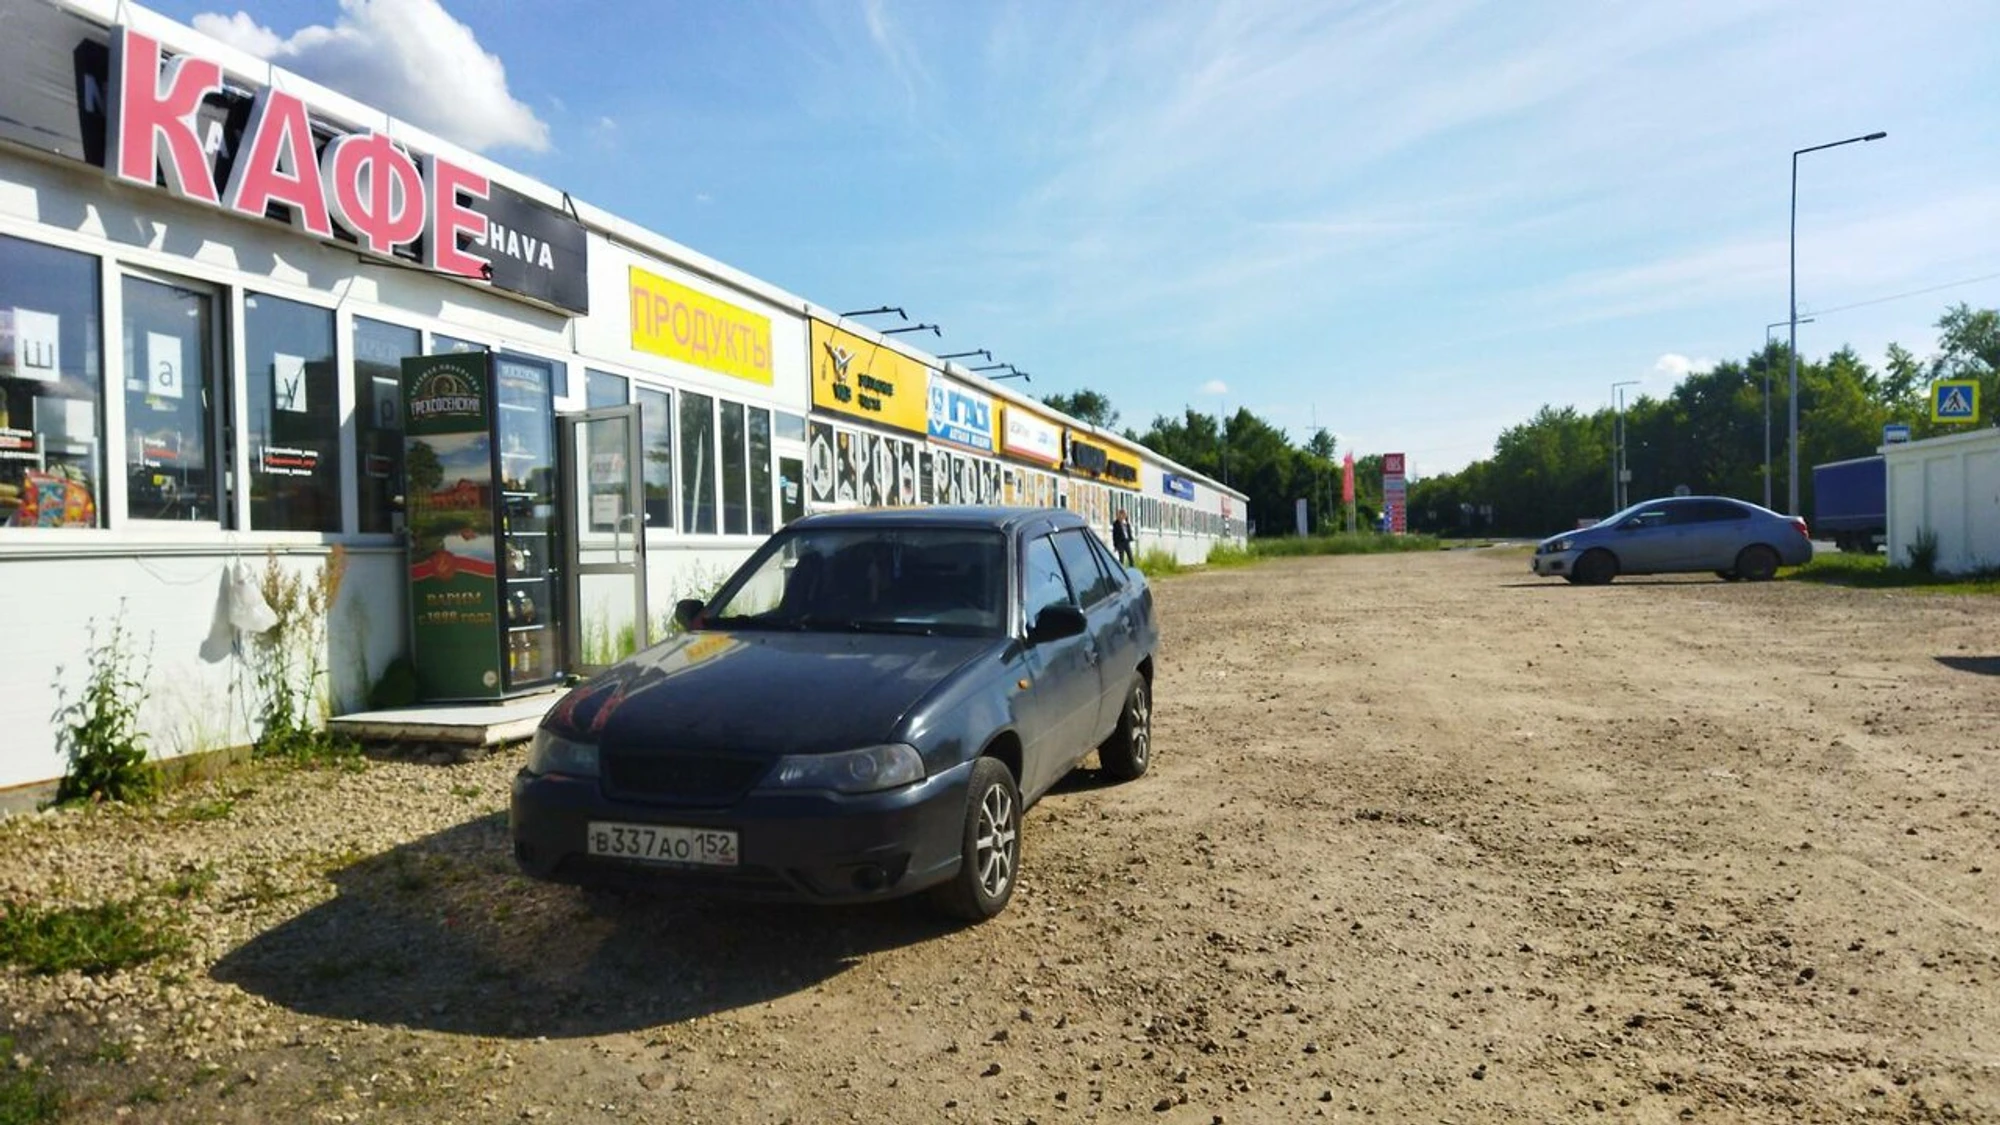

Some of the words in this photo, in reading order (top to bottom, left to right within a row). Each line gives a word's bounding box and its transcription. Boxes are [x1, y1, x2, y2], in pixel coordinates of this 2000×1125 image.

[116, 27, 491, 286] КАФЕ
[474, 220, 555, 271] HAVA
[633, 285, 773, 371] ПРОДУКТЫ
[596, 827, 690, 859] В337АО
[695, 833, 731, 855] 152
